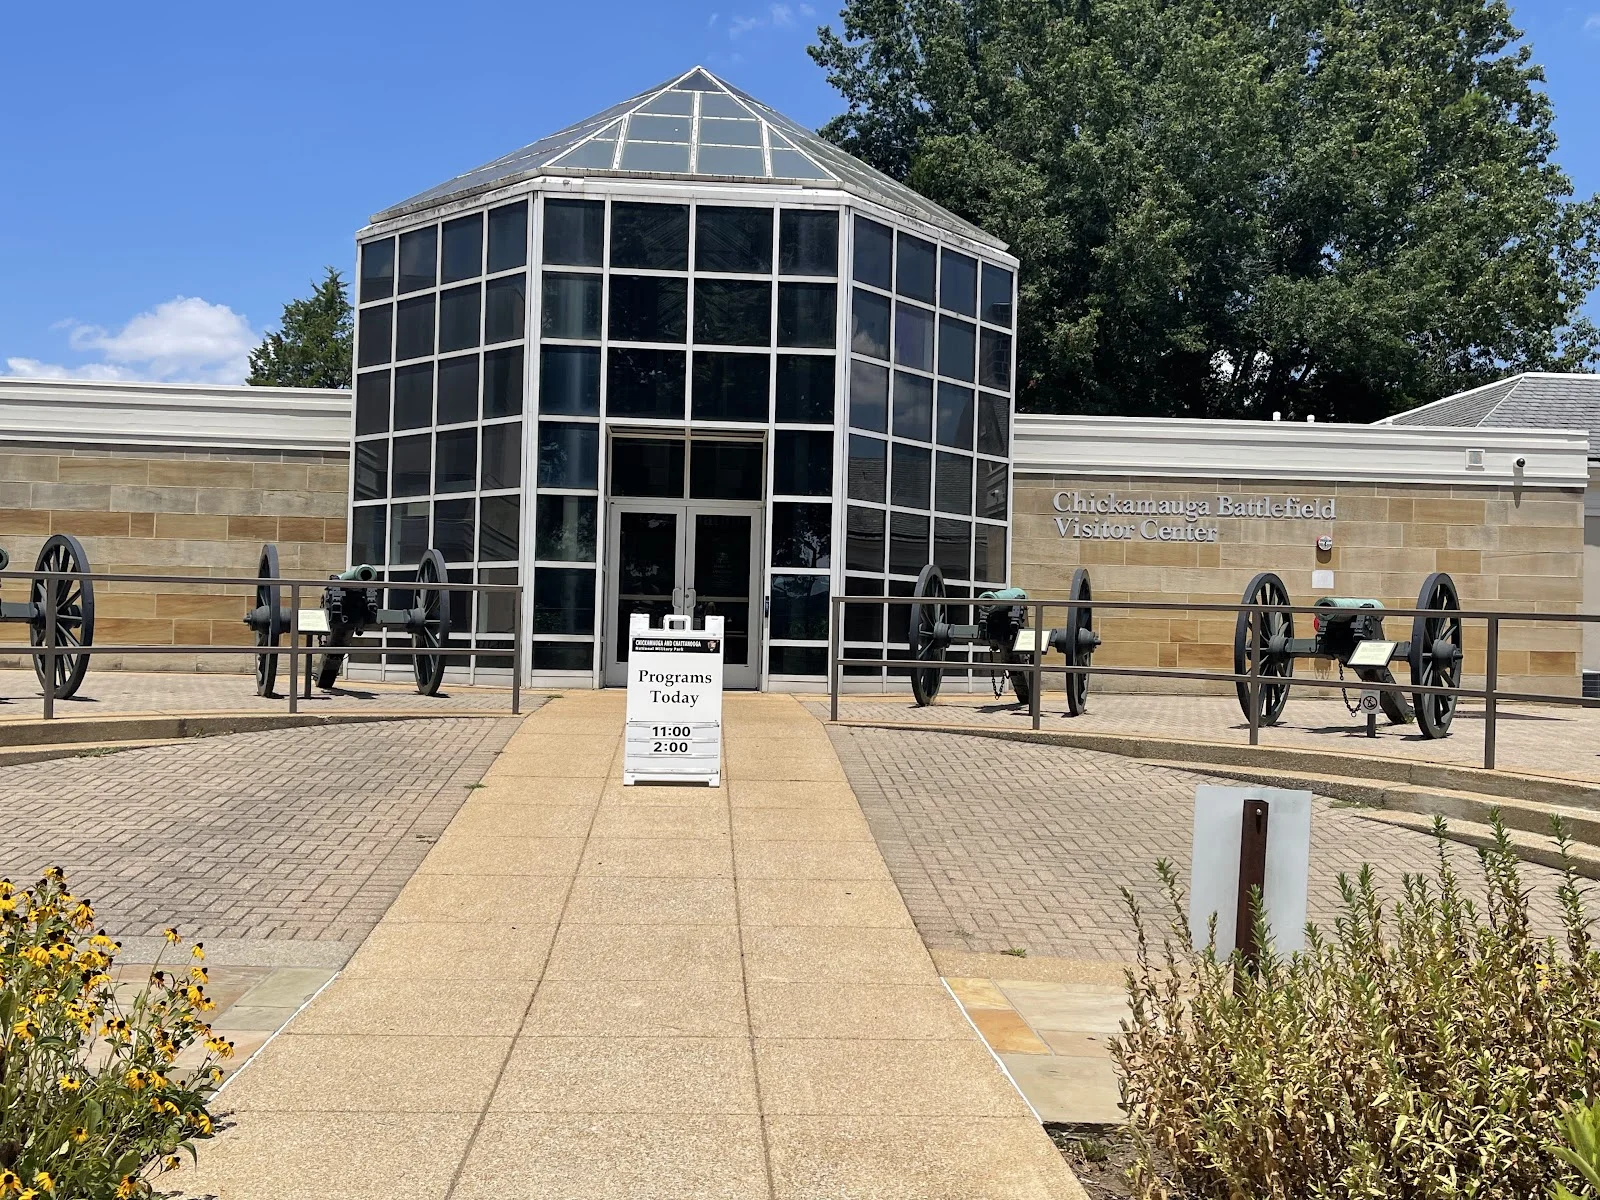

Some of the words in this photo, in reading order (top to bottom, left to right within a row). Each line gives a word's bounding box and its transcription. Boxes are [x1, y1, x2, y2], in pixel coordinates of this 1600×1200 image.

[1052, 491, 1211, 522] Chickamauga
[1216, 495, 1337, 520] Battlefield
[1054, 517, 1136, 540] Visitor
[1139, 519, 1218, 543] Center
[638, 670, 712, 687] Programs
[650, 690, 700, 708] Today
[652, 726, 691, 737] 11:00
[653, 742, 688, 753] 2:00
